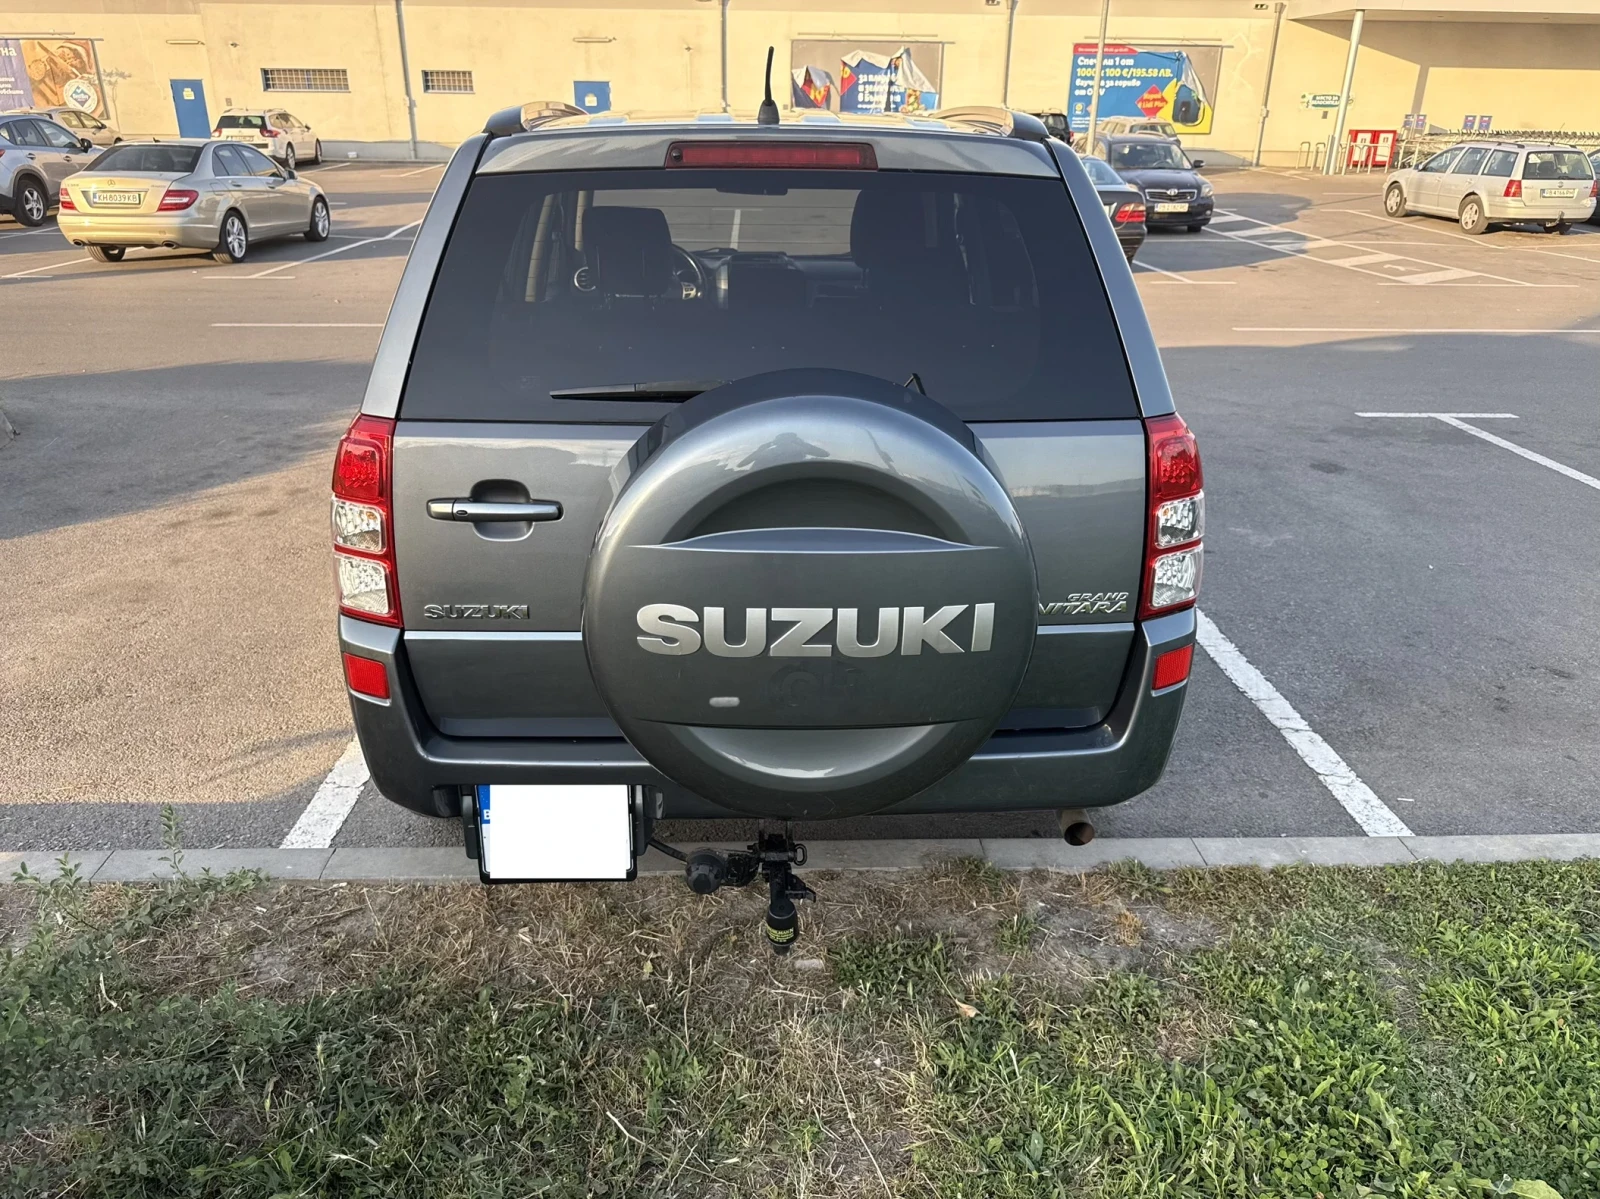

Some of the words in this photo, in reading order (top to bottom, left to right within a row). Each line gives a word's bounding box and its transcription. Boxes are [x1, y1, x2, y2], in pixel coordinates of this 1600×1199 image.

[1105, 68, 1122, 77] 100
[1087, 88, 1106, 96] OV
[1067, 591, 1129, 602] GRAND
[424, 604, 530, 620] SUZUKI
[1038, 601, 1127, 615] VITARA
[635, 602, 997, 658] SUZUKI
